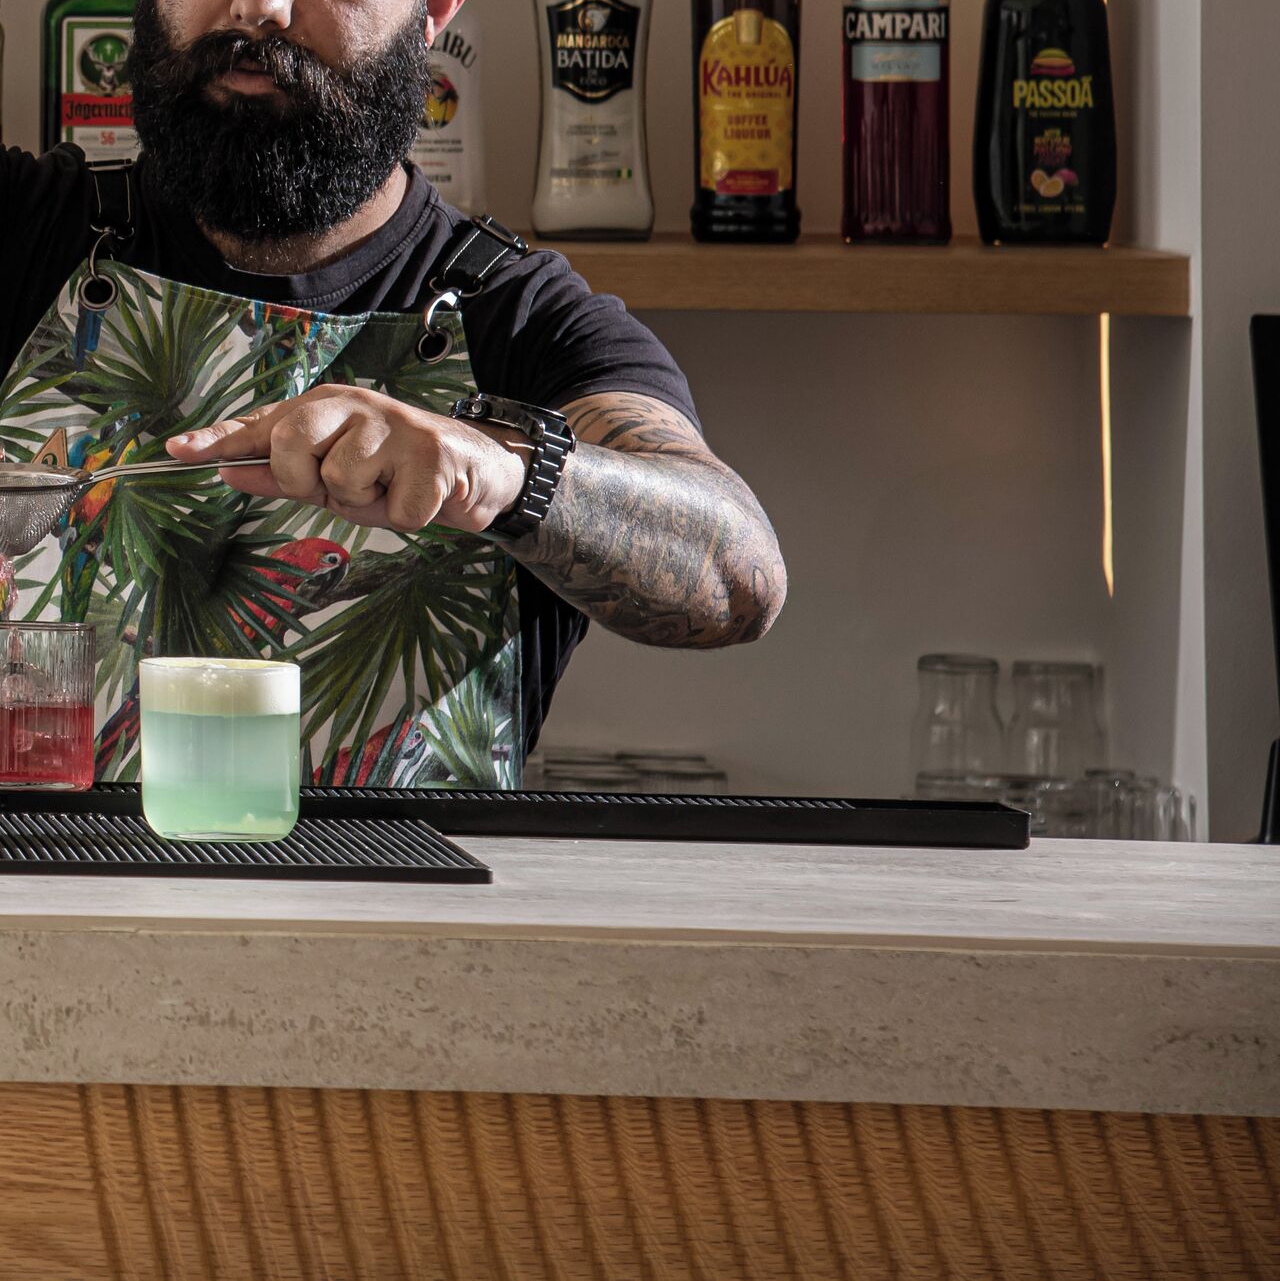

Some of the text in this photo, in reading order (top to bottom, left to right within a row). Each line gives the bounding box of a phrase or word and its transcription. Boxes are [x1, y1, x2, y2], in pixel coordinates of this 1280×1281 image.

[845, 11, 946, 40] CAMPARI
[428, 31, 478, 69] LIBU
[557, 33, 630, 48] MANGAROCA
[557, 49, 629, 68] BATIDA
[703, 58, 793, 97] KAHLÚA
